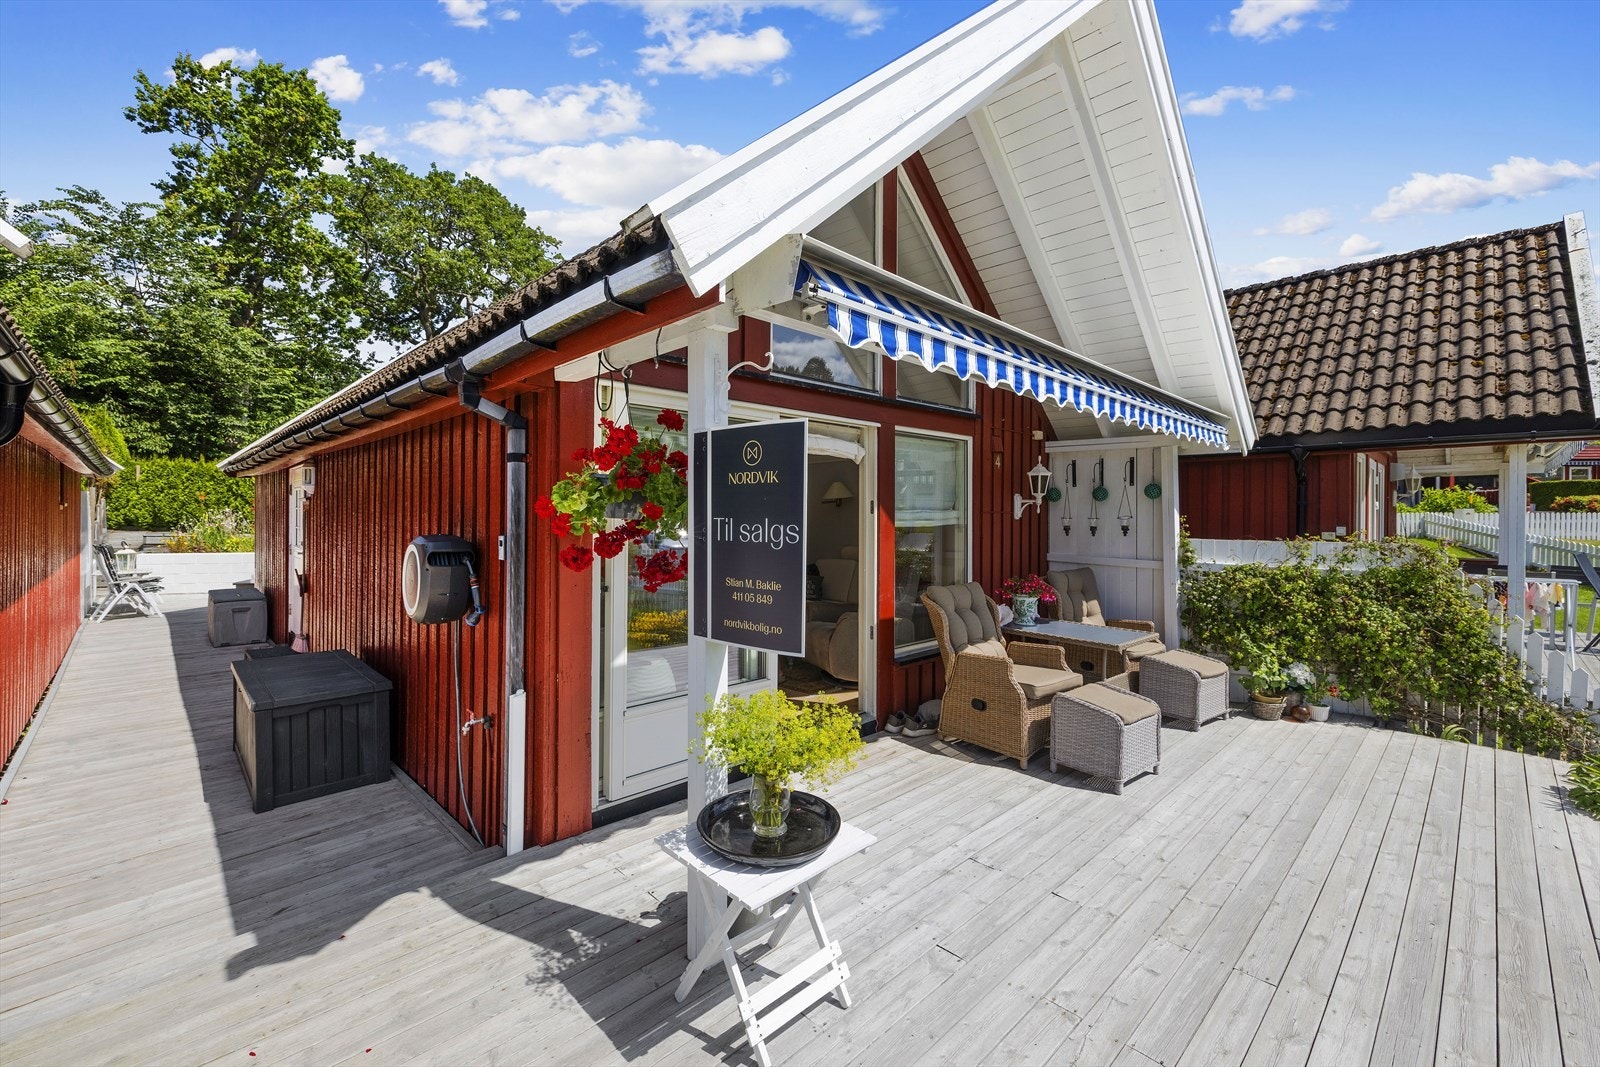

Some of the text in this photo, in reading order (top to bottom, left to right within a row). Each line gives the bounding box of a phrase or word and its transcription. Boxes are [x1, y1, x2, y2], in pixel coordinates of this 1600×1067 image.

[728, 470, 779, 485] NORDVIK
[713, 517, 800, 551] Til salgs
[725, 576, 782, 591] Stian M. Baklie
[732, 591, 773, 605] 411 05 849
[723, 618, 783, 635] nordvikbolig.no
